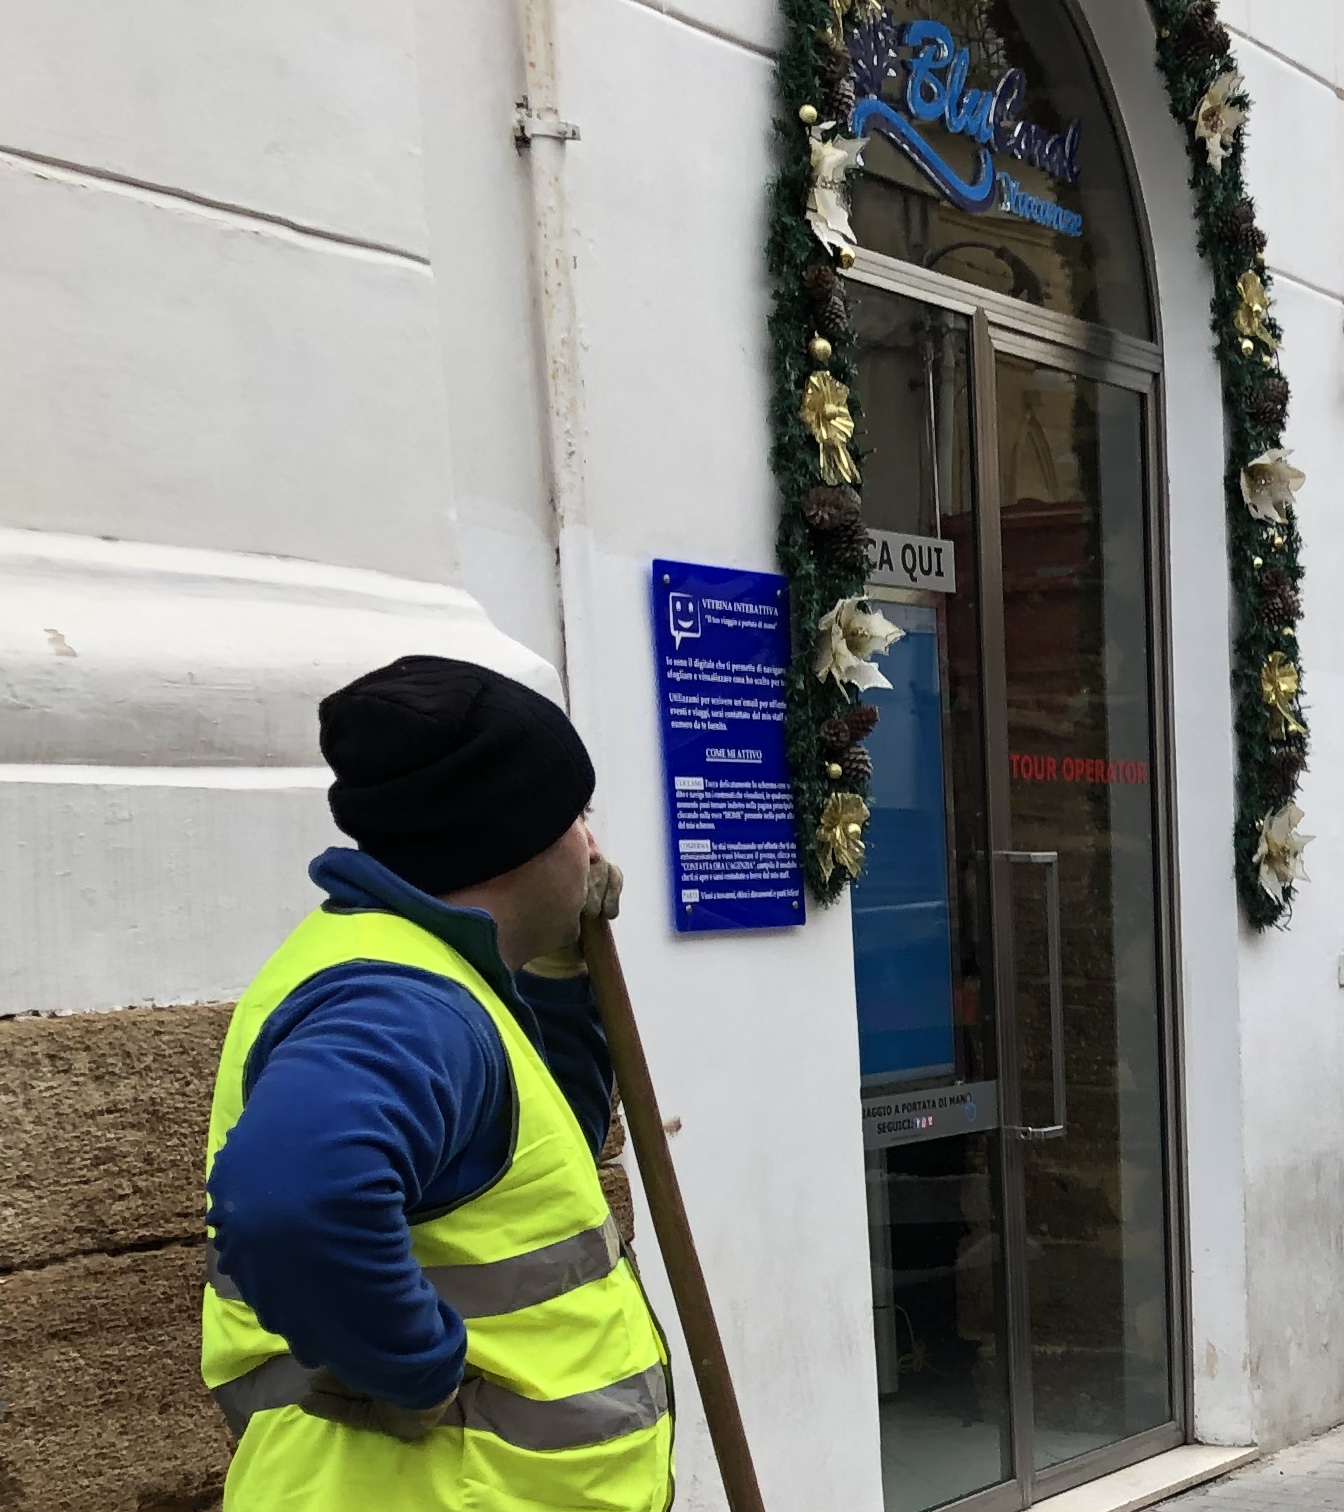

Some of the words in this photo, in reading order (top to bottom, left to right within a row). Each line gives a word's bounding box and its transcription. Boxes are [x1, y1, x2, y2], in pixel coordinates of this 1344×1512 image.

[901, 543, 944, 583] QUI
[734, 602, 778, 616] INTERATTIVA
[737, 749, 762, 759] ATTIVO
[1010, 753, 1057, 781] TOUR
[1062, 757, 1147, 784] OPERATOR
[894, 1104, 900, 1114] A
[902, 1099, 936, 1113] PORTATA
[939, 1097, 947, 1108] DI
